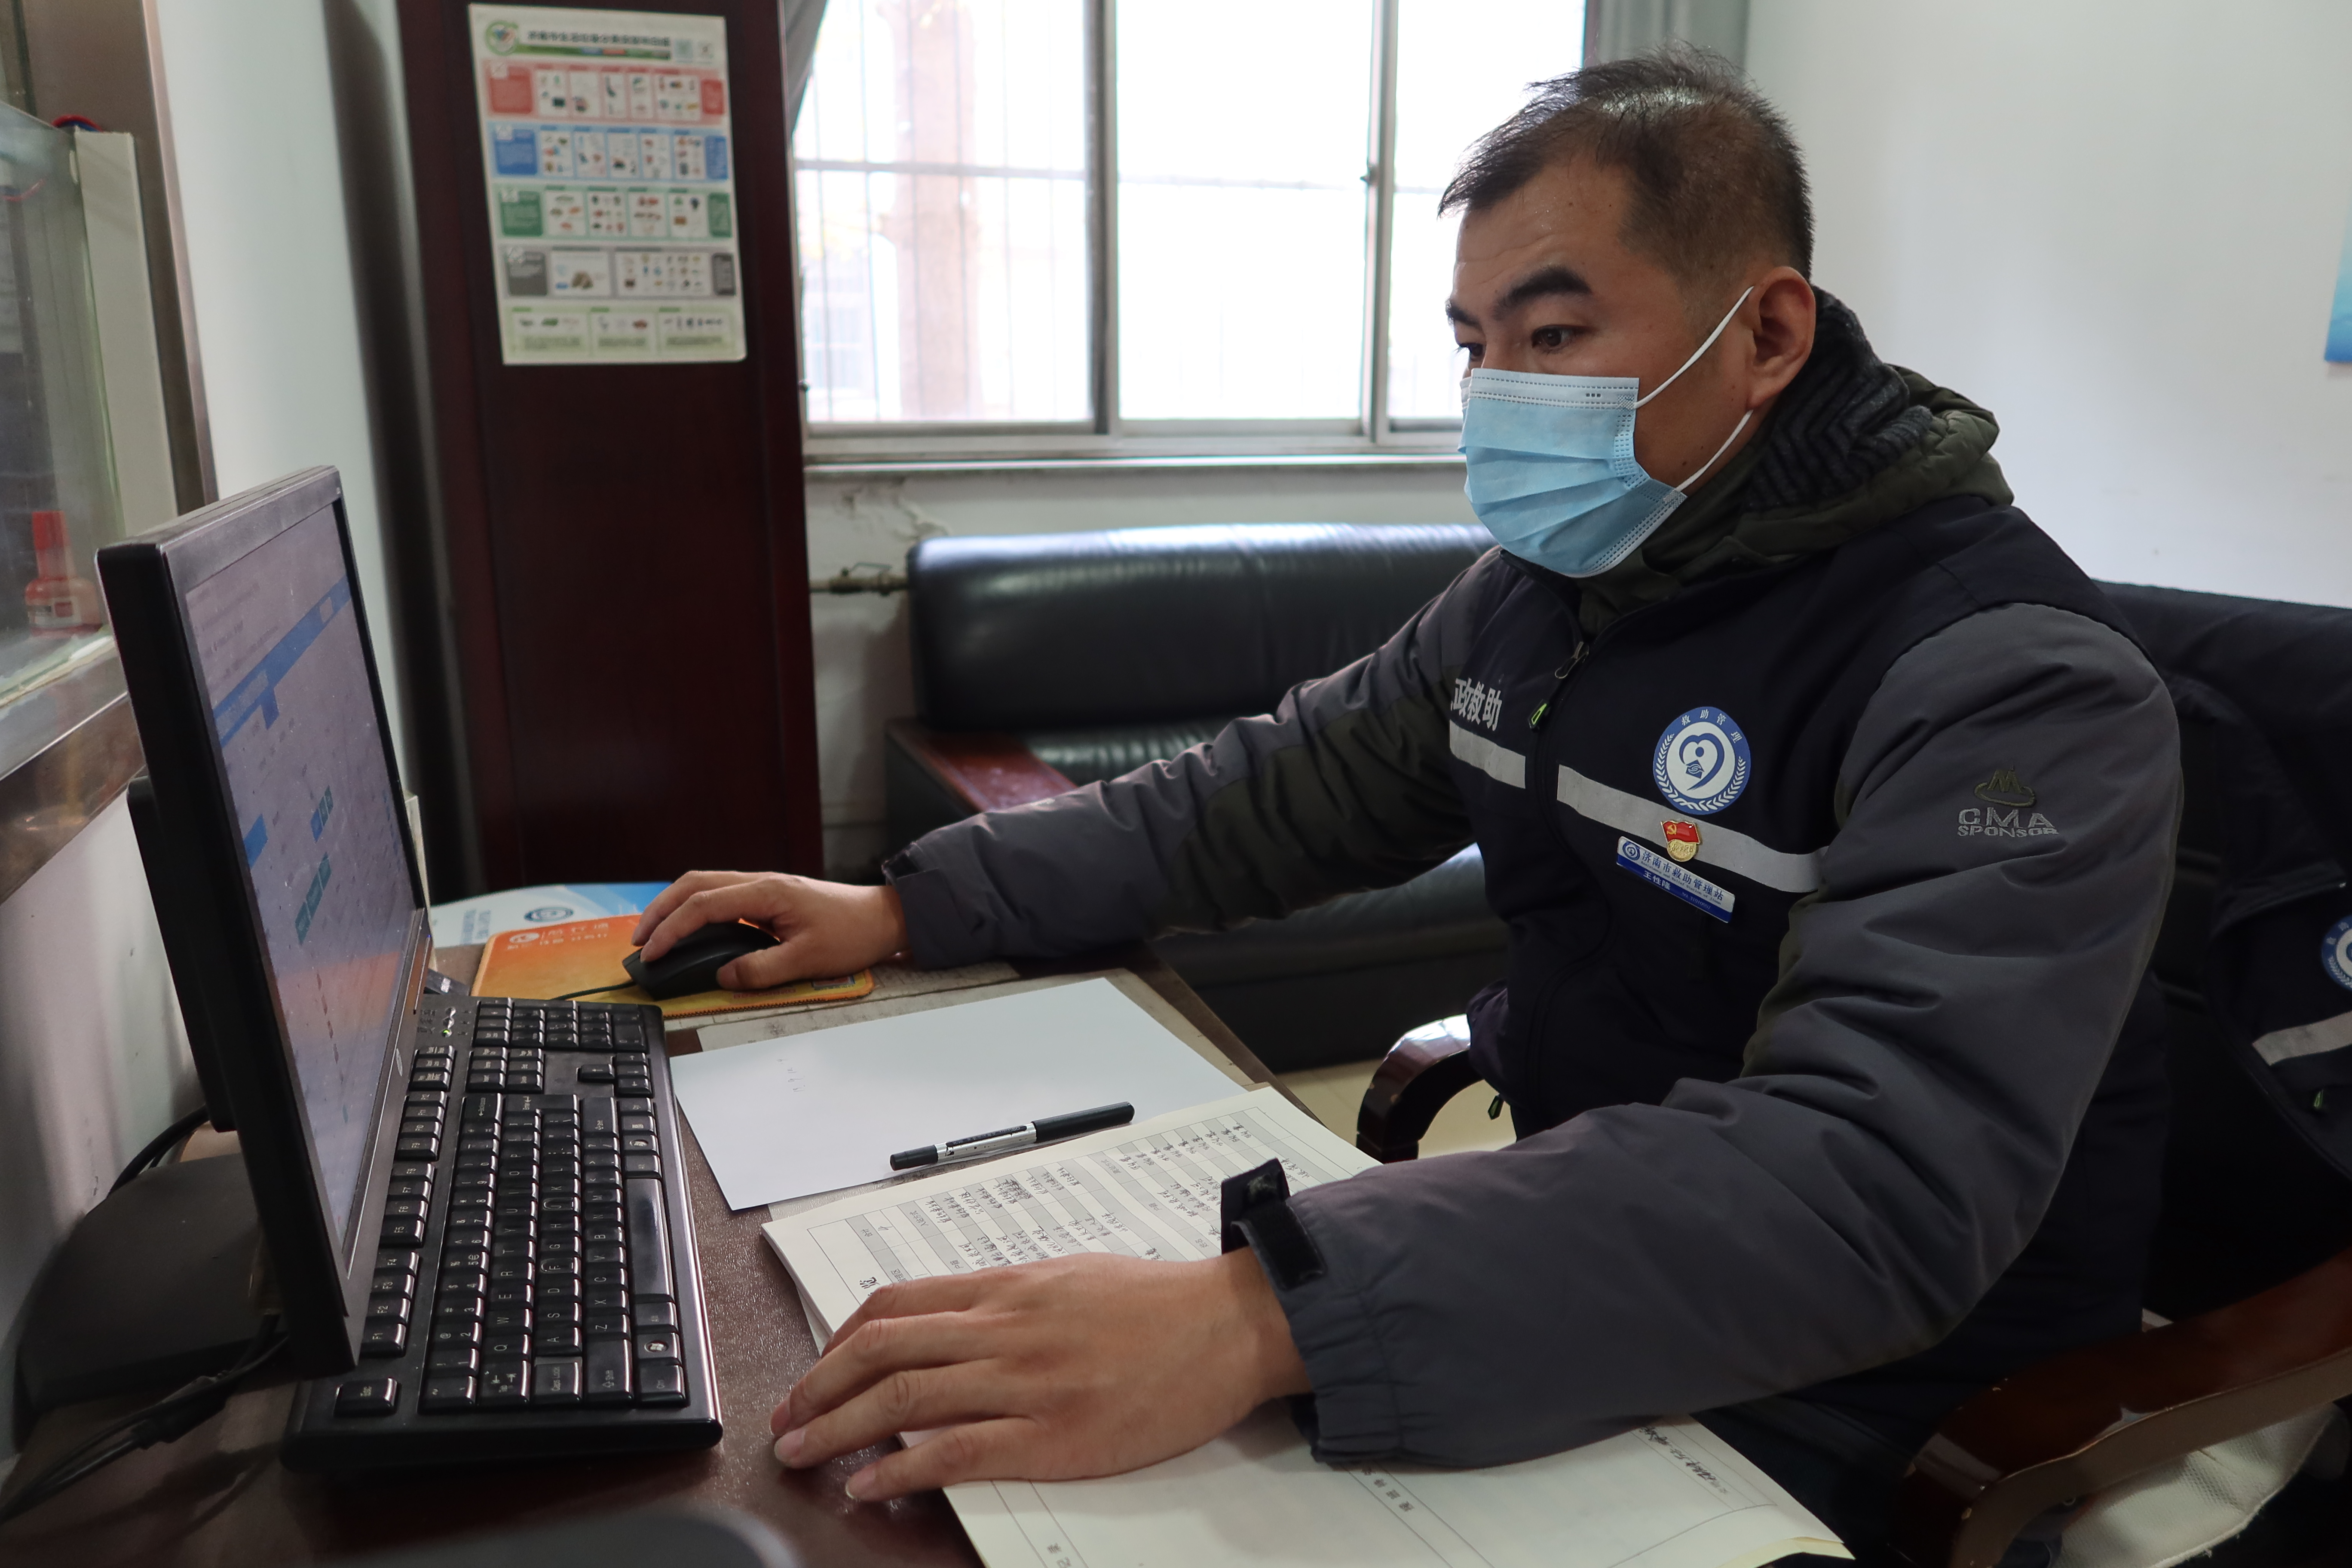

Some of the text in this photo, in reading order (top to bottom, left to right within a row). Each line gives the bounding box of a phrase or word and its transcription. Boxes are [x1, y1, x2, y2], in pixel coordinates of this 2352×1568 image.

[1451, 677, 1502, 731] 政救助
[1681, 709, 1743, 743] 救助管理
[1957, 824, 2059, 837] SPONSOR
[1642, 851, 1724, 901] 济南市救助管理站
[910, 1210, 928, 1226] 入站方式
[861, 1228, 873, 1237] 合计
[1195, 1239, 1209, 1248] 姓名
[950, 1260, 964, 1269] 户籍
